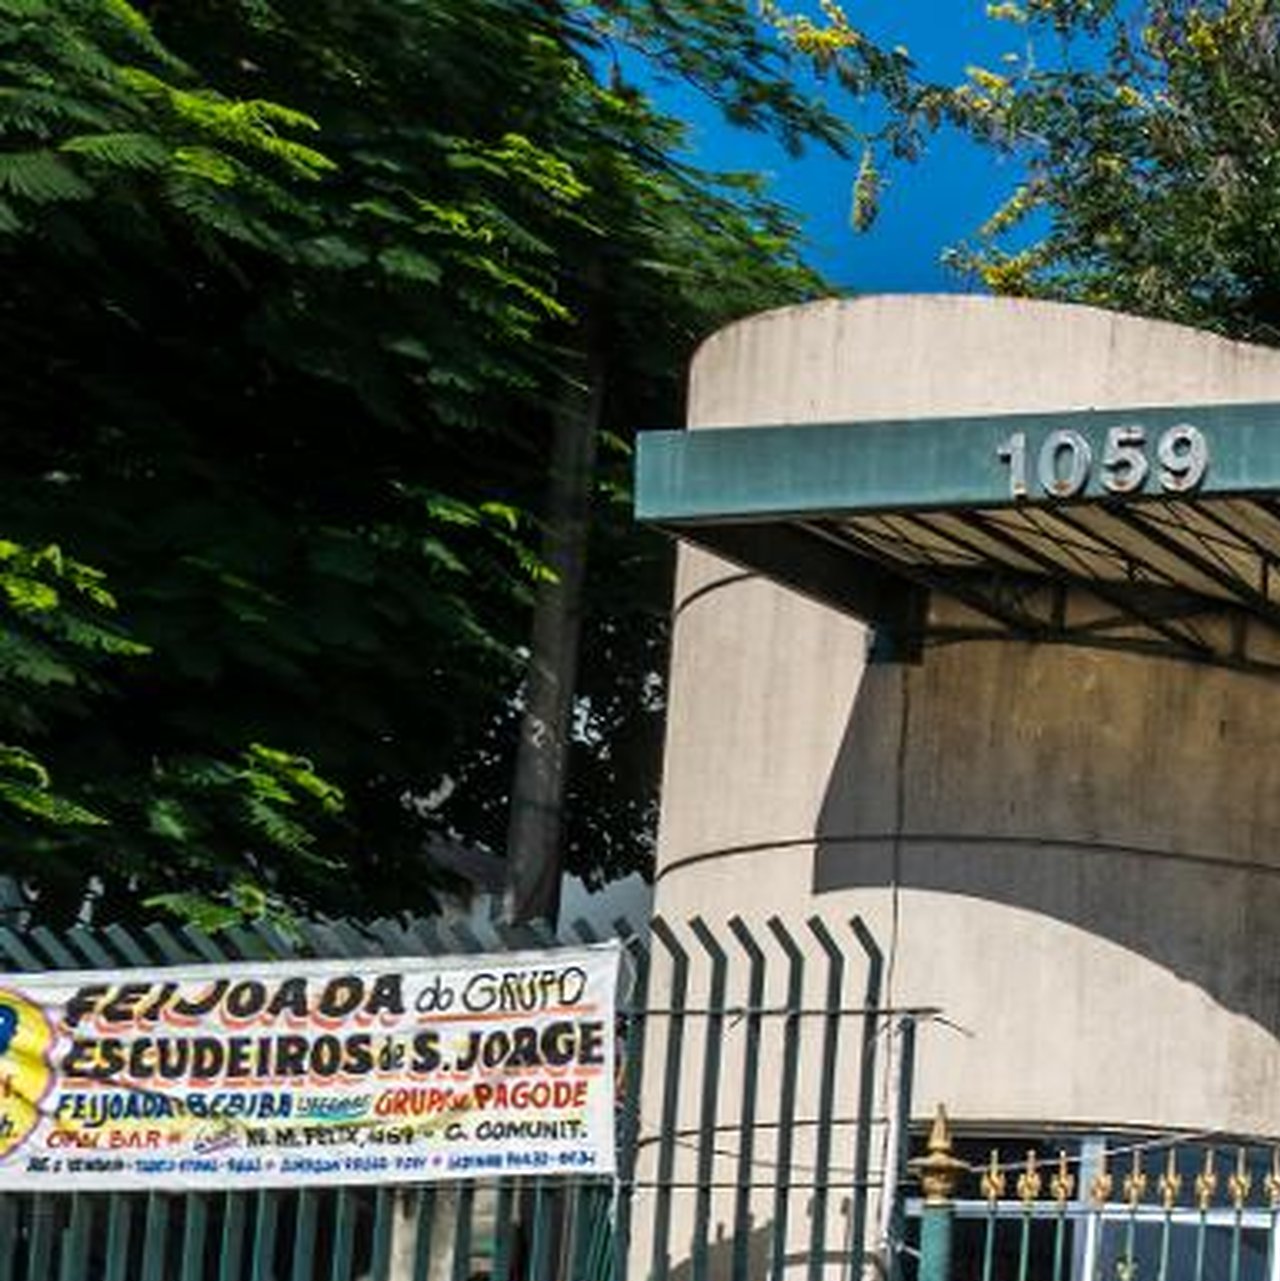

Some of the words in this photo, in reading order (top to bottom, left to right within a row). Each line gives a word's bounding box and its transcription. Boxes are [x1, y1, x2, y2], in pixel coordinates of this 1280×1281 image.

[998, 424, 1209, 498] 1059
[62, 973, 405, 1027] FEIJOADA
[415, 975, 454, 1013] do
[462, 966, 587, 1013] GRUPO
[61, 1033, 373, 1079] ESCUDEIROS
[379, 1035, 405, 1071] de
[54, 1090, 175, 1128] FEIJOADA
[473, 1081, 588, 1110] PAGODE
[109, 1130, 161, 1149] BAR
